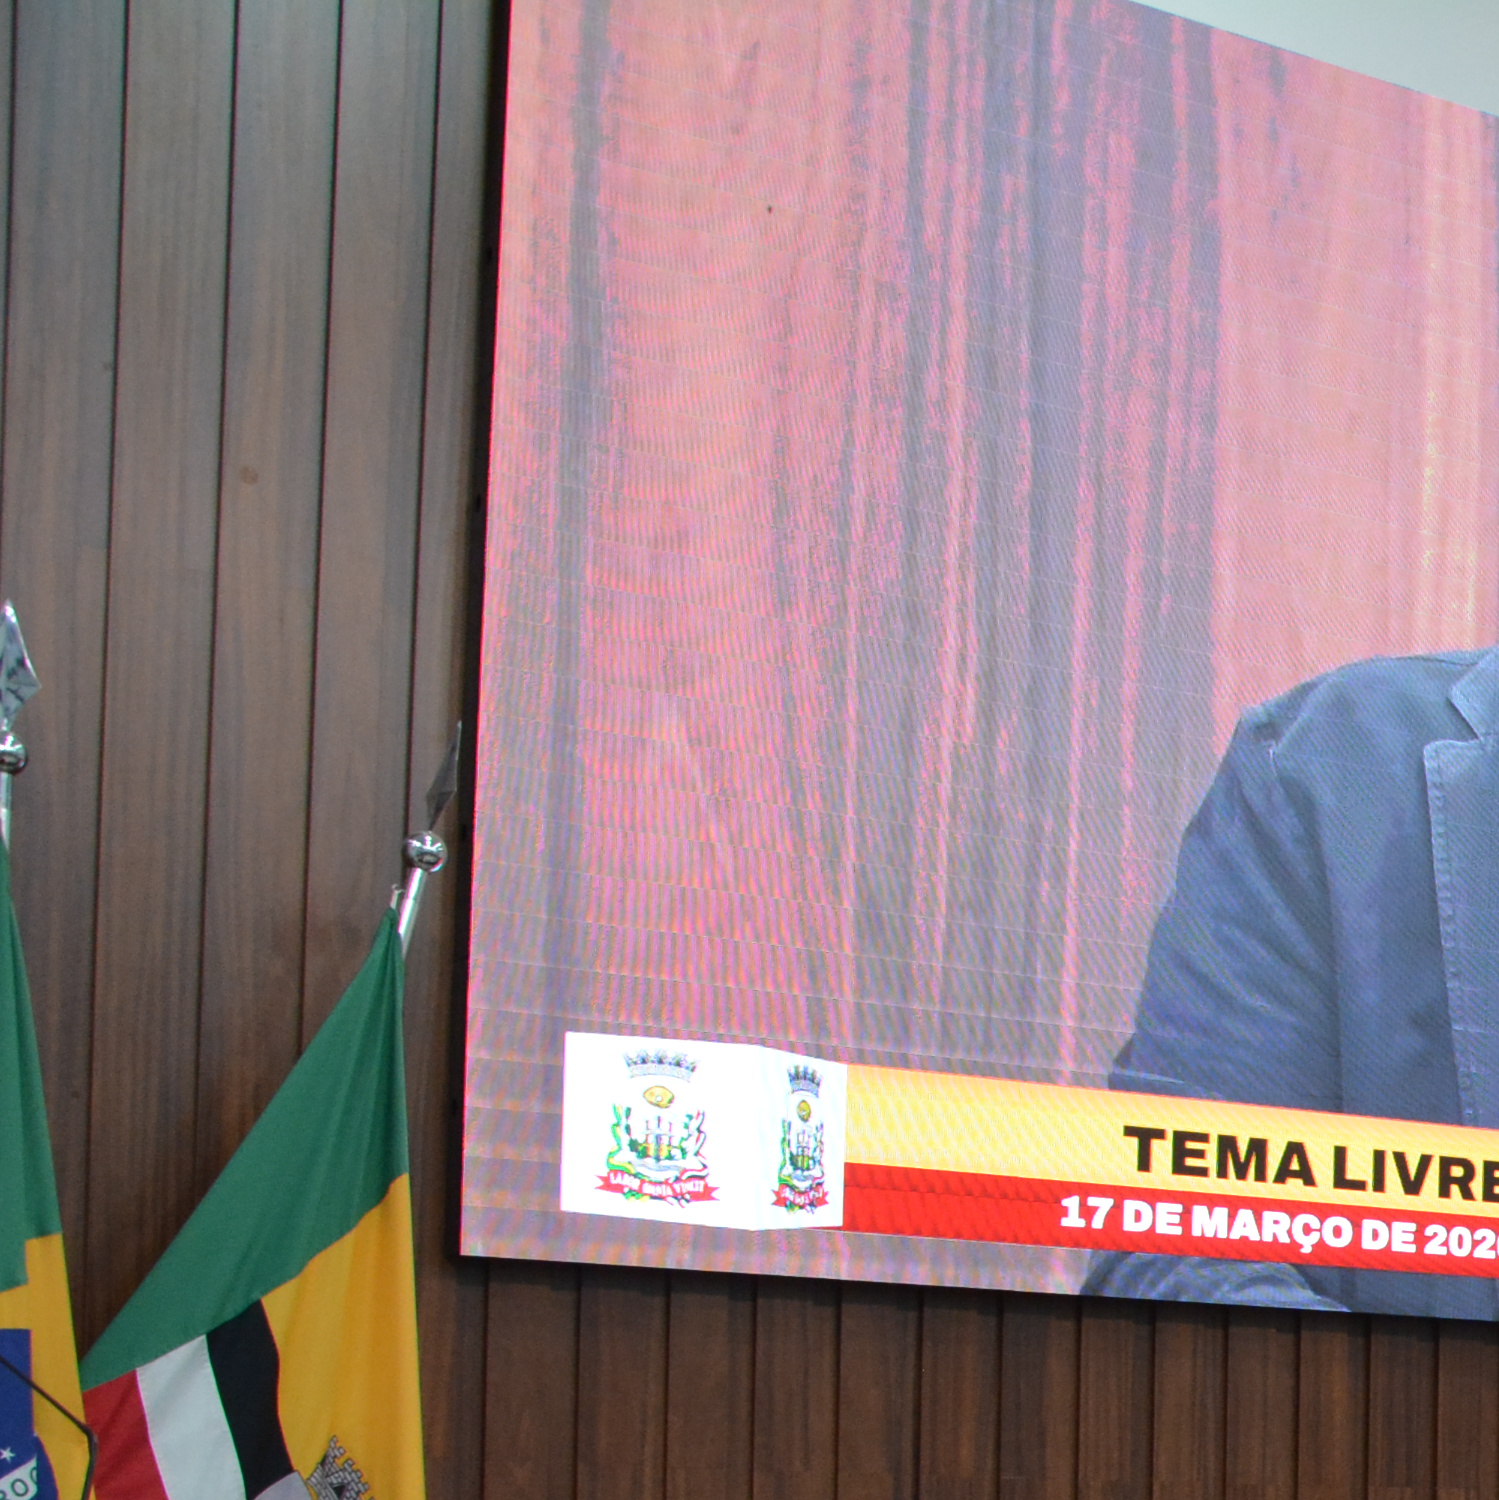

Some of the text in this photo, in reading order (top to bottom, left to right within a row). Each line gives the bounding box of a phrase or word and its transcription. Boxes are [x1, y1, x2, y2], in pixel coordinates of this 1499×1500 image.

[1122, 1125, 1316, 1189] TEMA
[1060, 1195, 1115, 1230] 17
[1123, 1201, 1183, 1236] DE
[1191, 1207, 1354, 1255] MARÇO
[1360, 1220, 1419, 1254] DE
